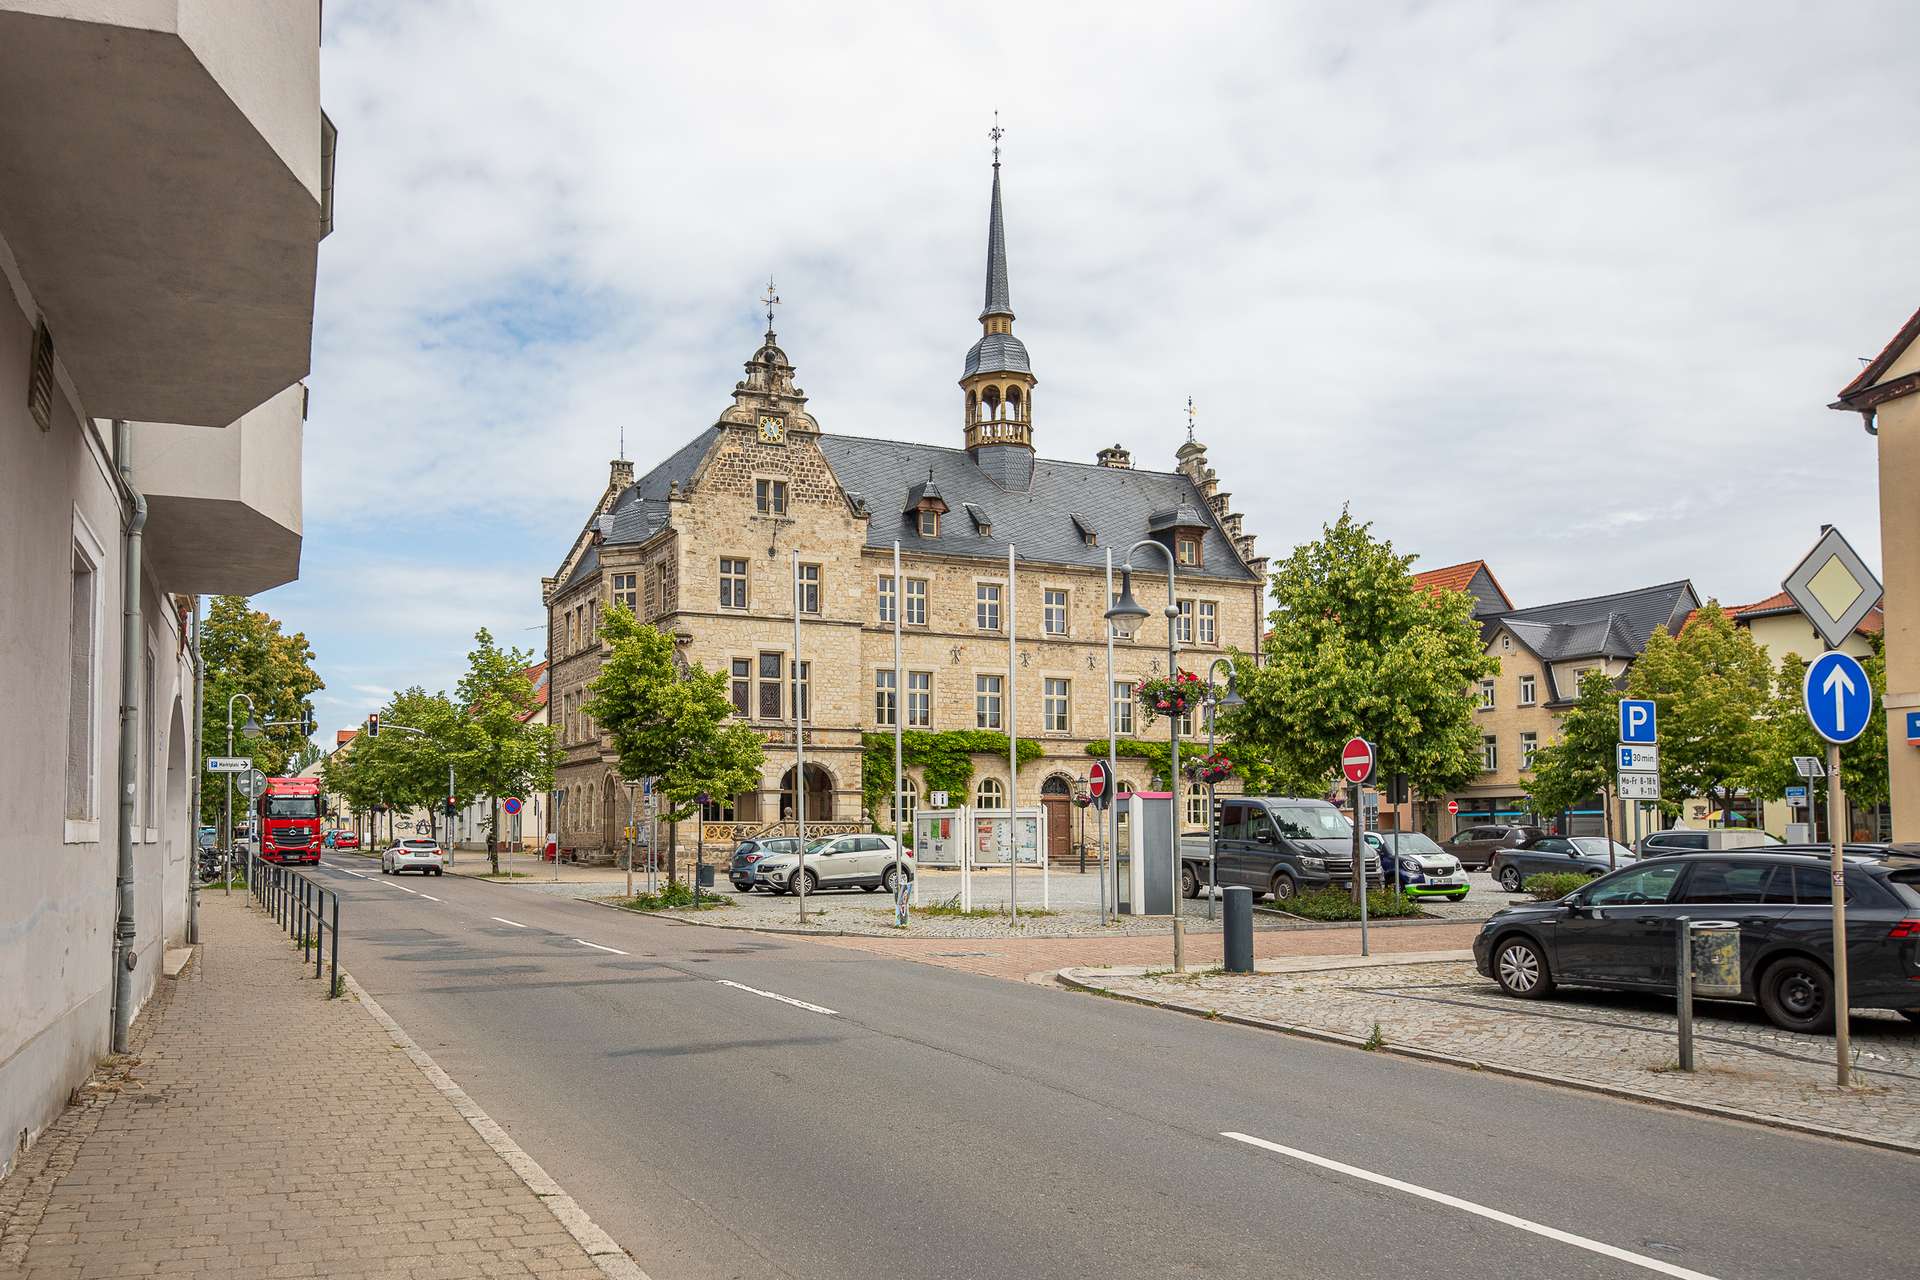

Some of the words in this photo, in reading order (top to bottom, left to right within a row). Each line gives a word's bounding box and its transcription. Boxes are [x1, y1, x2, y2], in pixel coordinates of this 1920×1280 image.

[1629, 706, 1647, 737] P
[1633, 753, 1641, 762] 30
[1621, 776, 1638, 785] Mo-Fr
[1621, 786, 1629, 795] Sa
